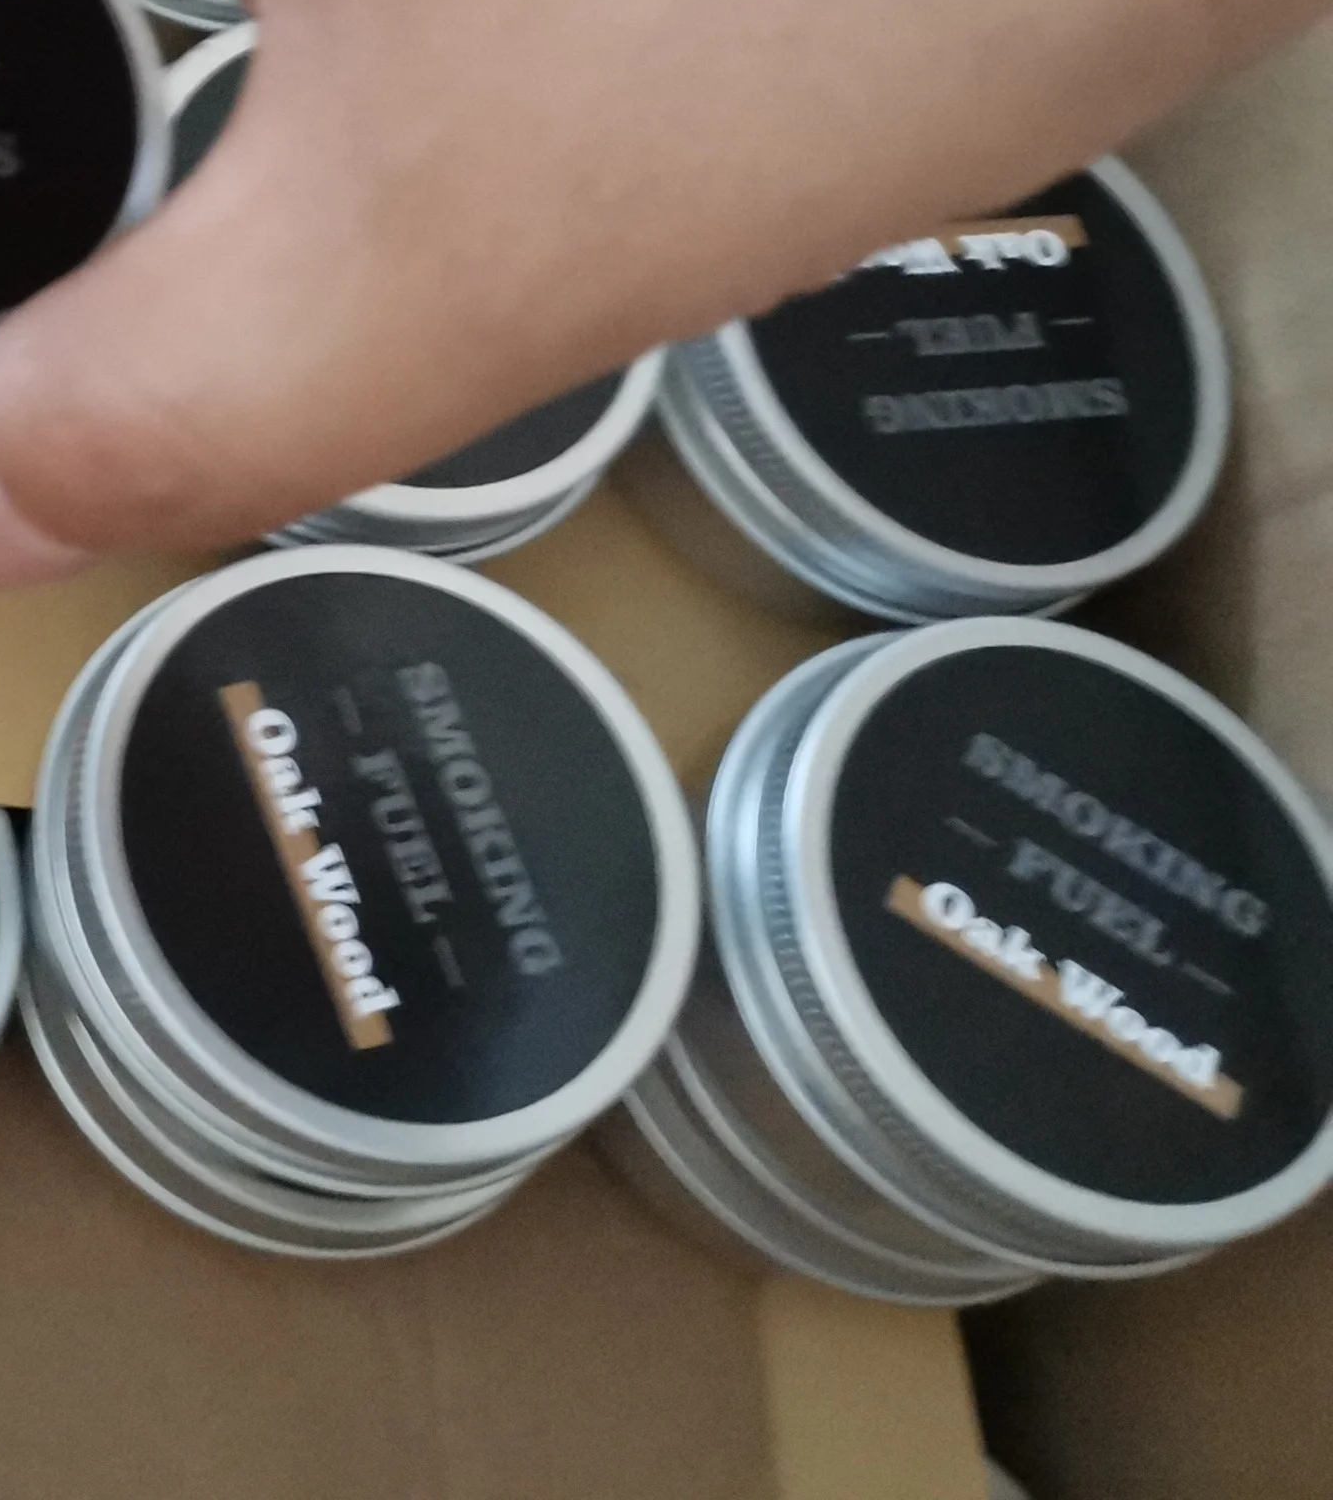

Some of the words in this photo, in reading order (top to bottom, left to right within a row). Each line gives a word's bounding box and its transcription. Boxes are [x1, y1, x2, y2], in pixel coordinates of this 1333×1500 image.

[956, 228, 1070, 269] Oak
[248, 705, 324, 833] Oak
[299, 841, 404, 1019] Wood
[351, 747, 456, 925] FUEL
[395, 660, 566, 979] SMOKING
[960, 732, 1274, 941] SMOKING
[1007, 836, 1180, 970] FUEL
[922, 881, 1047, 981] Oak
[1057, 957, 1223, 1089] Wood
